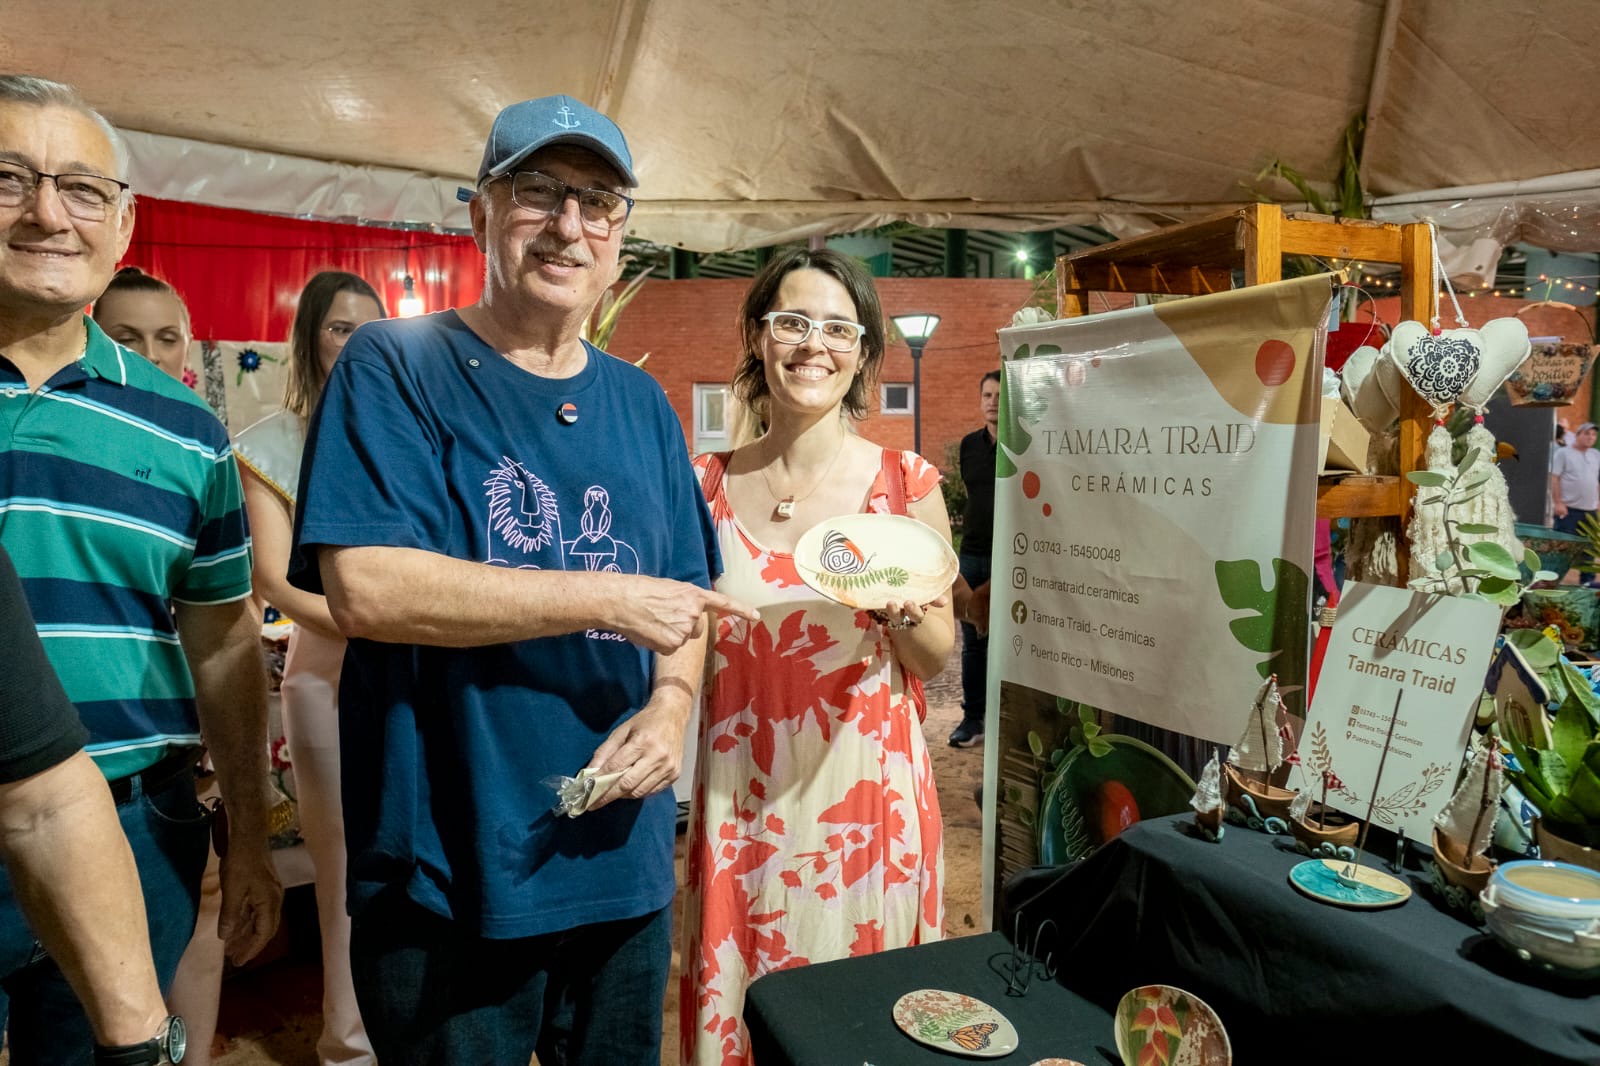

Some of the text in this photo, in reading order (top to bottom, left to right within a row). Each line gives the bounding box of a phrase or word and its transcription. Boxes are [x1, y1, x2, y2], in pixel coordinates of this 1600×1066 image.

[1042, 422, 1257, 456] TAMARA TRAID
[1071, 472, 1213, 497] CERÁMICAS
[1033, 540, 1062, 555] 03743
[1070, 544, 1121, 562] 15450048
[1032, 575, 1140, 605] tamaratraid.ceramicas
[1031, 609, 1065, 628] Tamara
[1067, 616, 1091, 634] Traid
[1099, 623, 1156, 648] Cerámicas
[1352, 626, 1467, 665] CERÁMICAS
[1030, 644, 1060, 663] Puerto
[1061, 651, 1082, 668] Rico
[1090, 658, 1135, 682] Misiones
[1348, 654, 1457, 695] Tamara Traid
